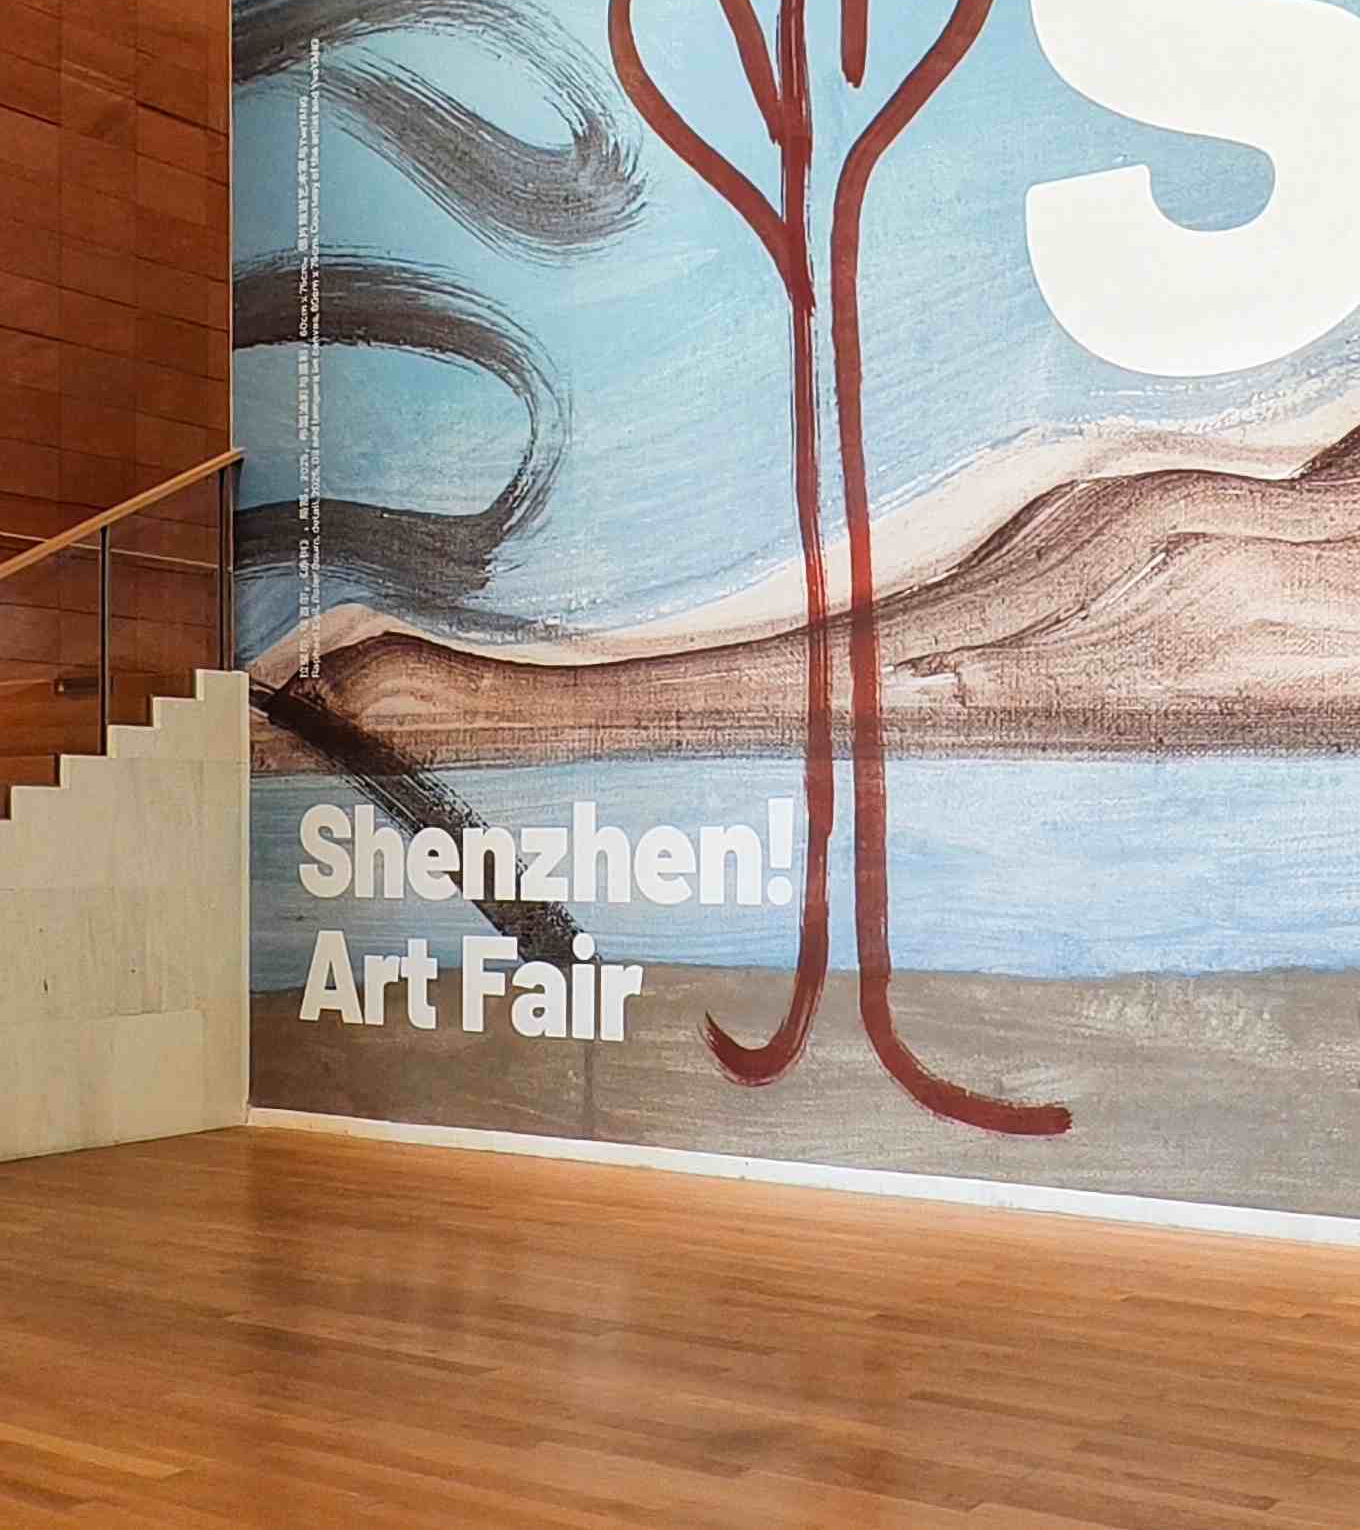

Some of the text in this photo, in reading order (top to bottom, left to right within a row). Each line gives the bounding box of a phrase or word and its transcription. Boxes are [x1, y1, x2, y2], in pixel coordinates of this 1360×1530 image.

[298, 797, 796, 905] Shenzhen!
[299, 930, 643, 1041] Art Fair
